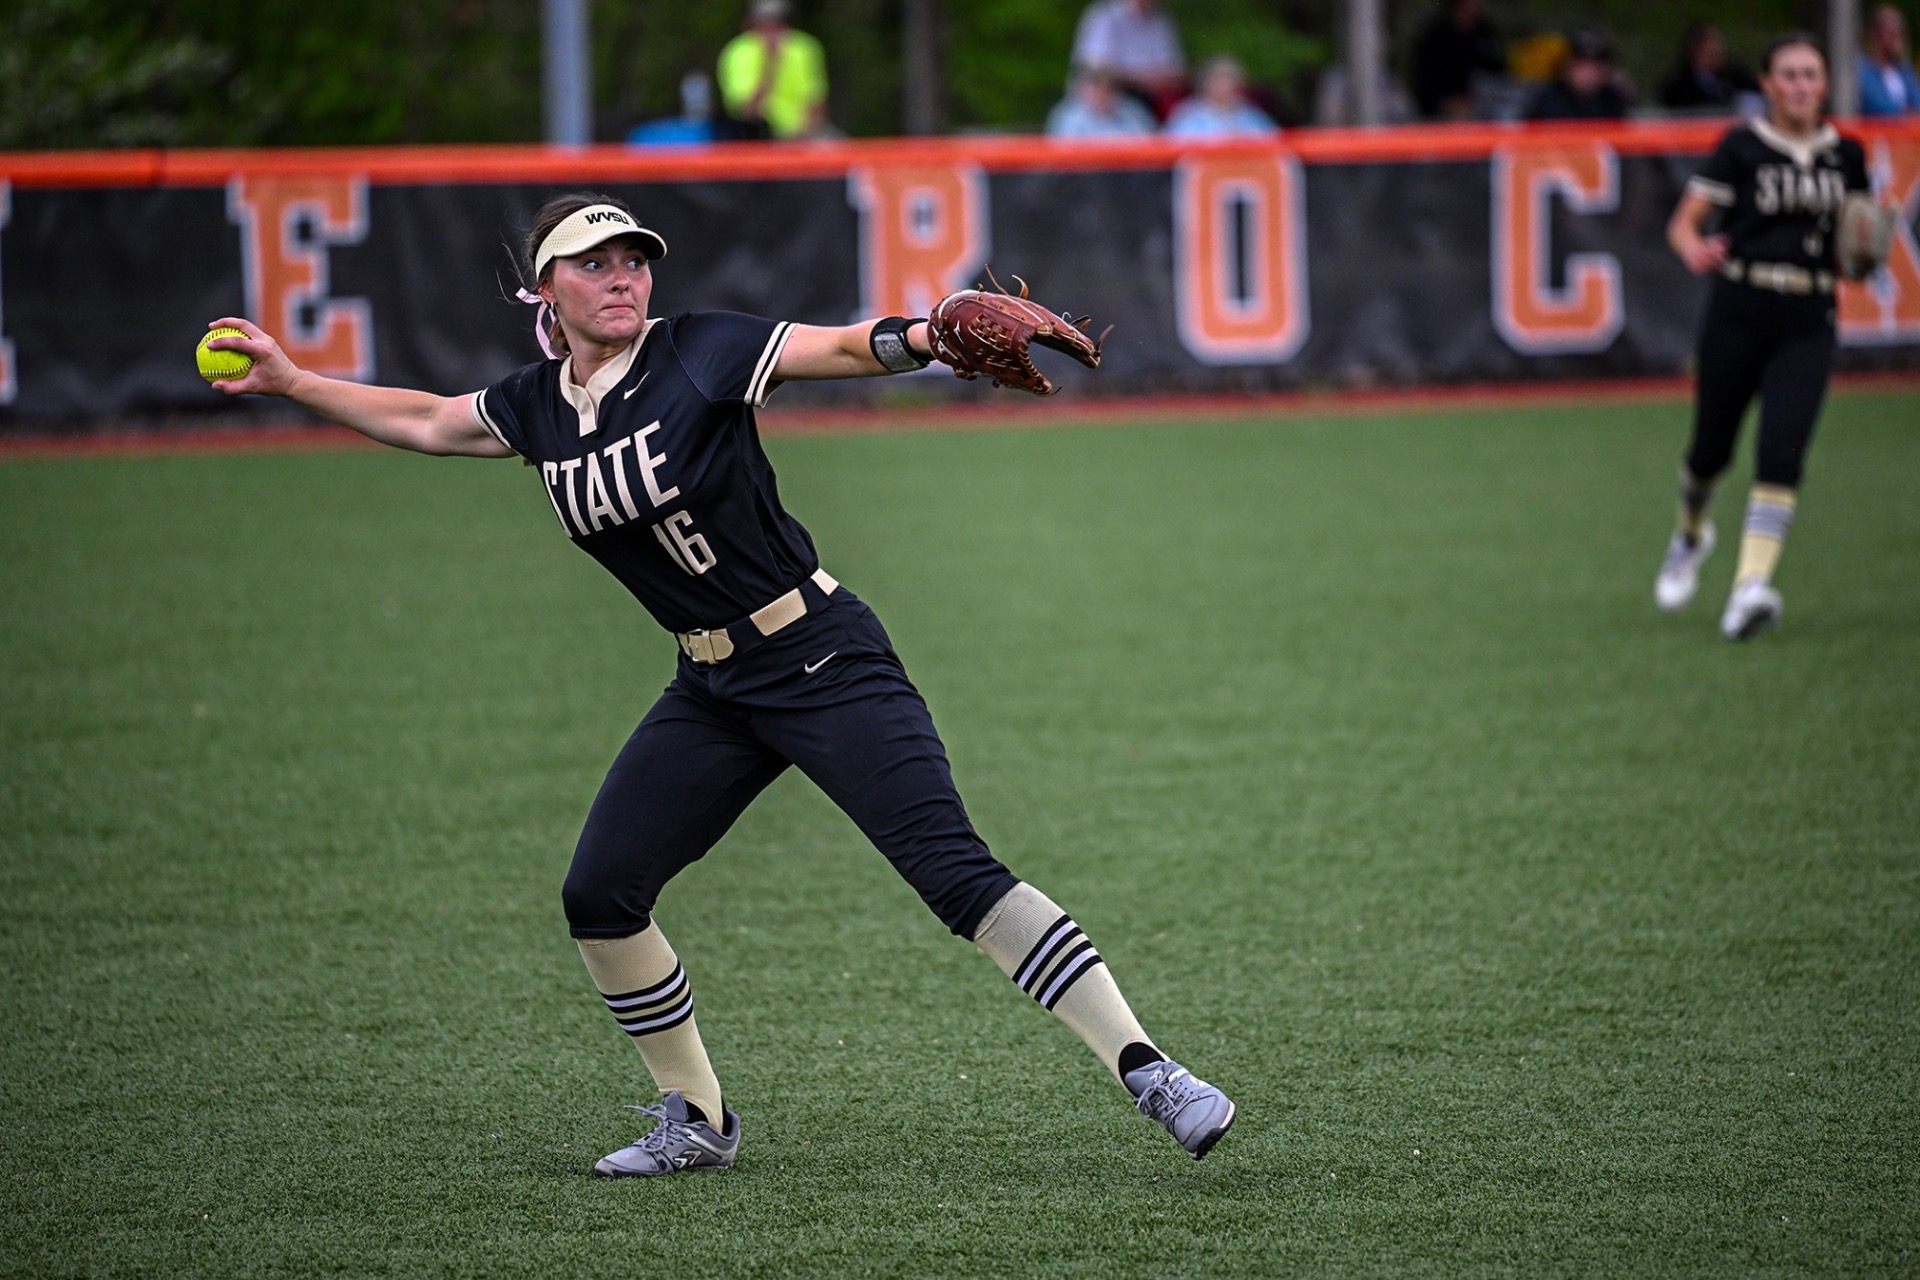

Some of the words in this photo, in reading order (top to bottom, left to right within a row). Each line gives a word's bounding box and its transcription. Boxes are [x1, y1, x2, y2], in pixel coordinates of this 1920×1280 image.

[585, 211, 630, 226] WVSU
[542, 419, 681, 538] STATE
[651, 509, 718, 577] 16
